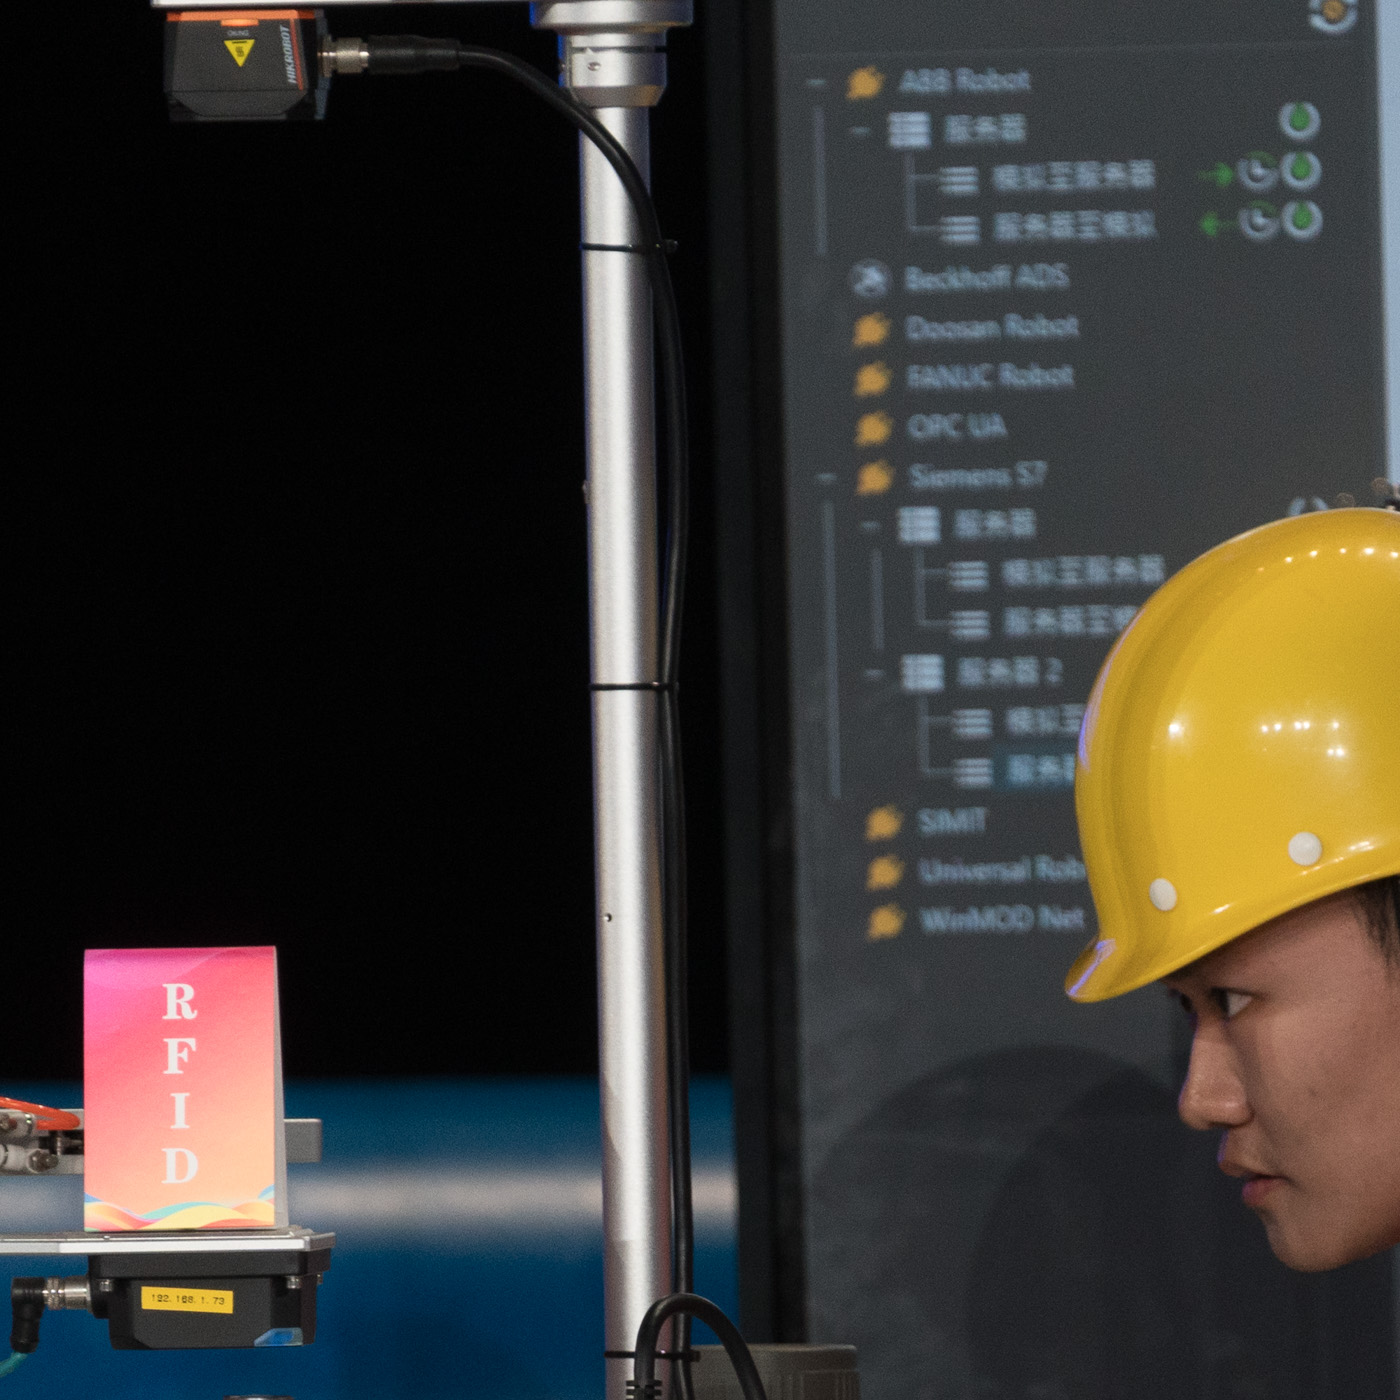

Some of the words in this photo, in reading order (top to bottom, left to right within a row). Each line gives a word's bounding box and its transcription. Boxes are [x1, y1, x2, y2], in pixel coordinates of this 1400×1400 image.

[279, 24, 299, 85] HIKROBOT
[955, 67, 1031, 91] Robot
[905, 264, 1011, 291] Beckhoff
[1016, 263, 1070, 290] ADS
[905, 315, 1000, 342] Doosan
[1004, 313, 1079, 339] Robot
[907, 363, 993, 390] FANUC
[999, 363, 1074, 388] Robot
[907, 413, 963, 439] OPC
[966, 412, 1007, 438] UA
[910, 464, 1011, 490] Siemens
[1016, 461, 1048, 487] S7
[1045, 656, 1063, 685] 2
[918, 855, 1032, 885] Universal
[920, 905, 1035, 932] WinMOD
[161, 982, 200, 1186] RFID
